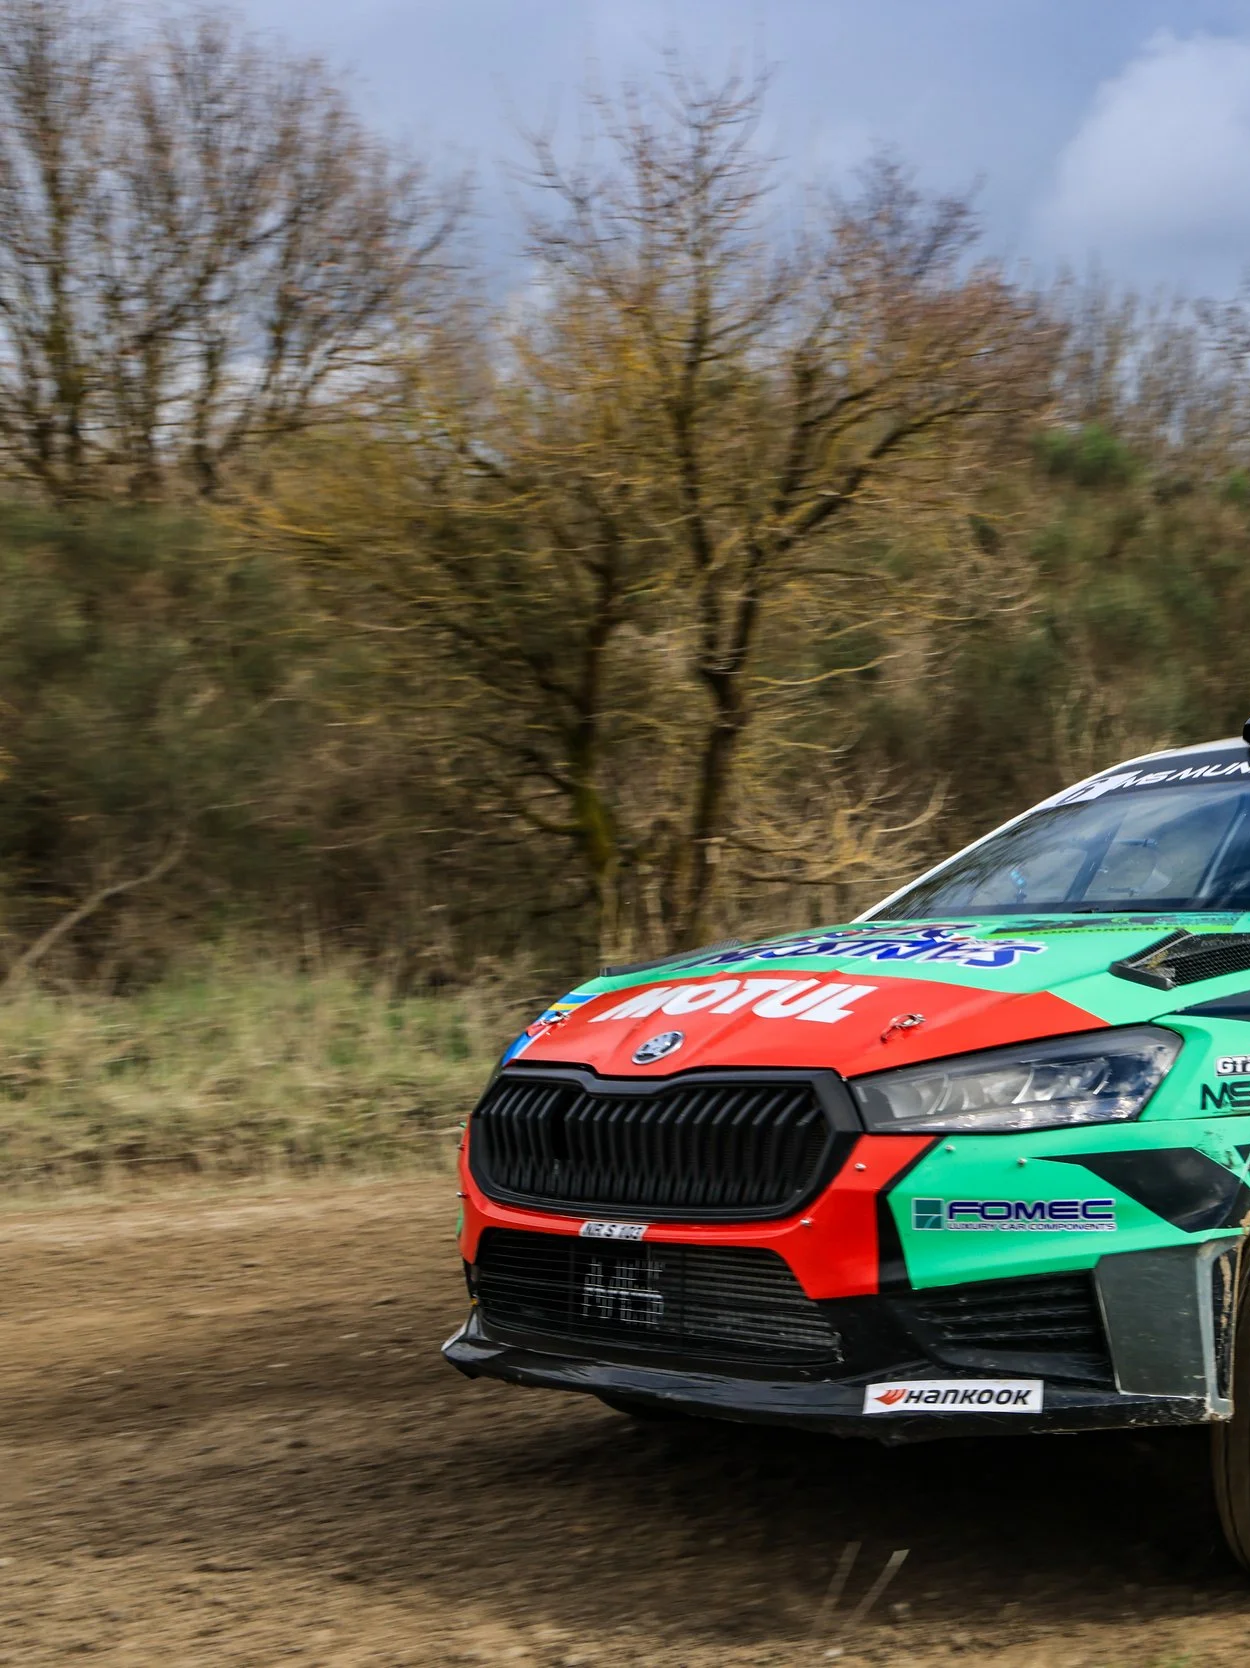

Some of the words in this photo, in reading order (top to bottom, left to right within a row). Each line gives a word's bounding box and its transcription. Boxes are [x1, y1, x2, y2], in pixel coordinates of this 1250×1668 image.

[588, 977, 879, 1024] MOTUL
[948, 1200, 1114, 1220] FOMEC
[947, 1223, 996, 1231] LUXURY
[1000, 1223, 1026, 1231] CAR
[1029, 1222, 1116, 1231] COMPONENTS
